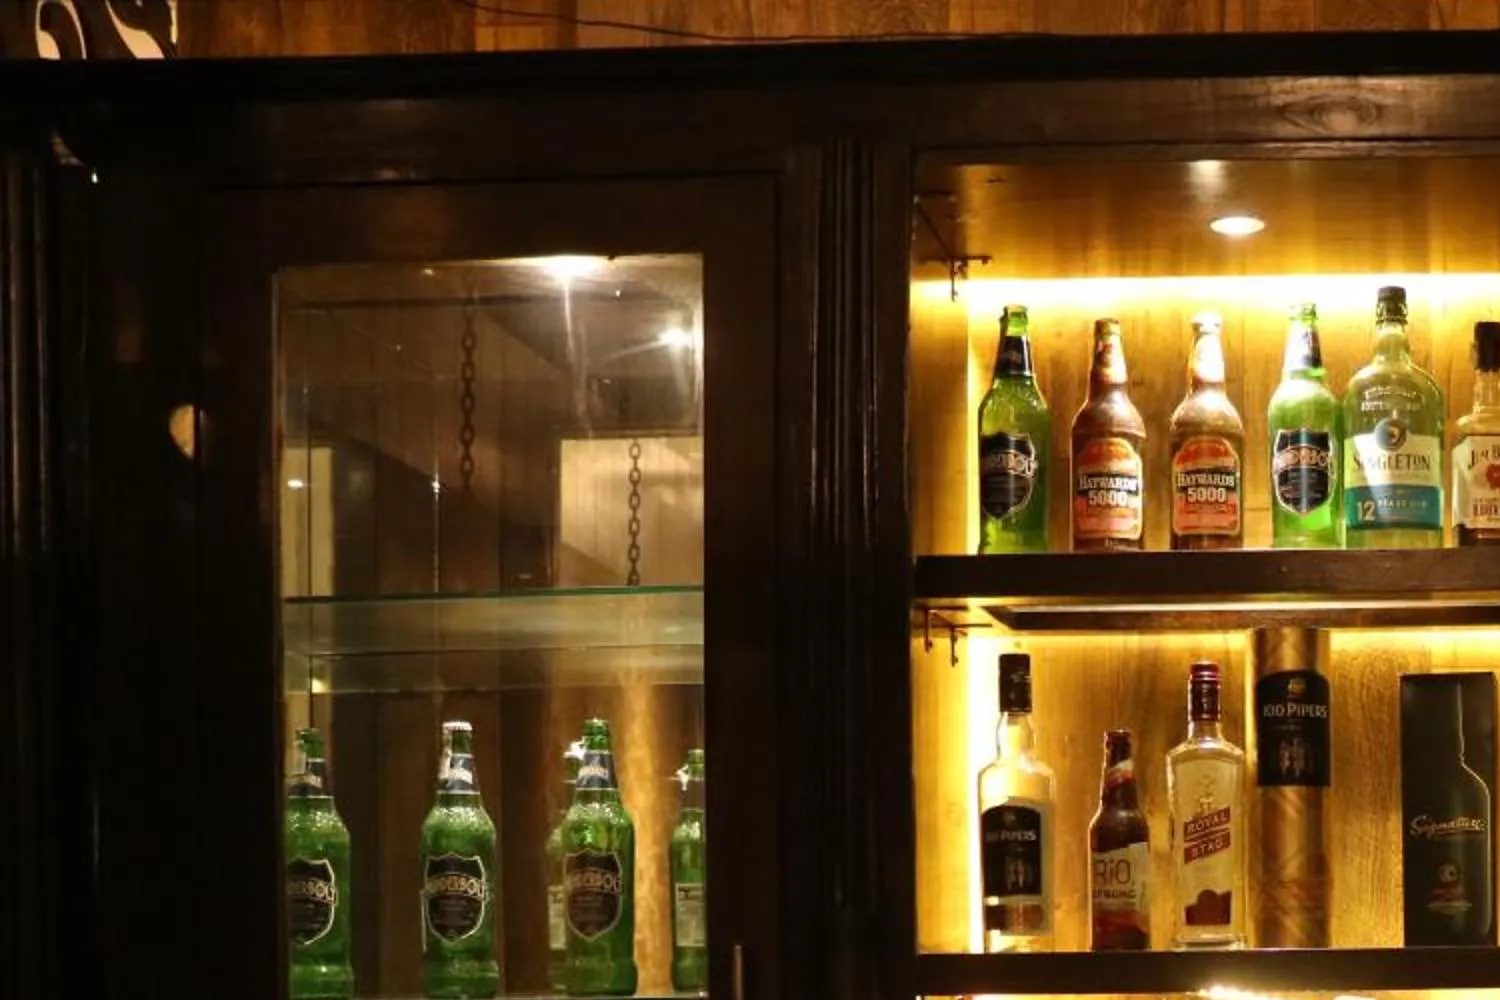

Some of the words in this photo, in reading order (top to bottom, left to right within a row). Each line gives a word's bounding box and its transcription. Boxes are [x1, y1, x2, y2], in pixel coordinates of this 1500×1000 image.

[1354, 454, 1430, 471] SNGLETON
[1177, 472, 1235, 487] HAYWARDS
[1087, 491, 1129, 506] 5000
[1187, 487, 1227, 503] 5000
[1356, 500, 1377, 522] 12
[1186, 811, 1228, 834] ROYAL
[1191, 838, 1226, 859] STAG
